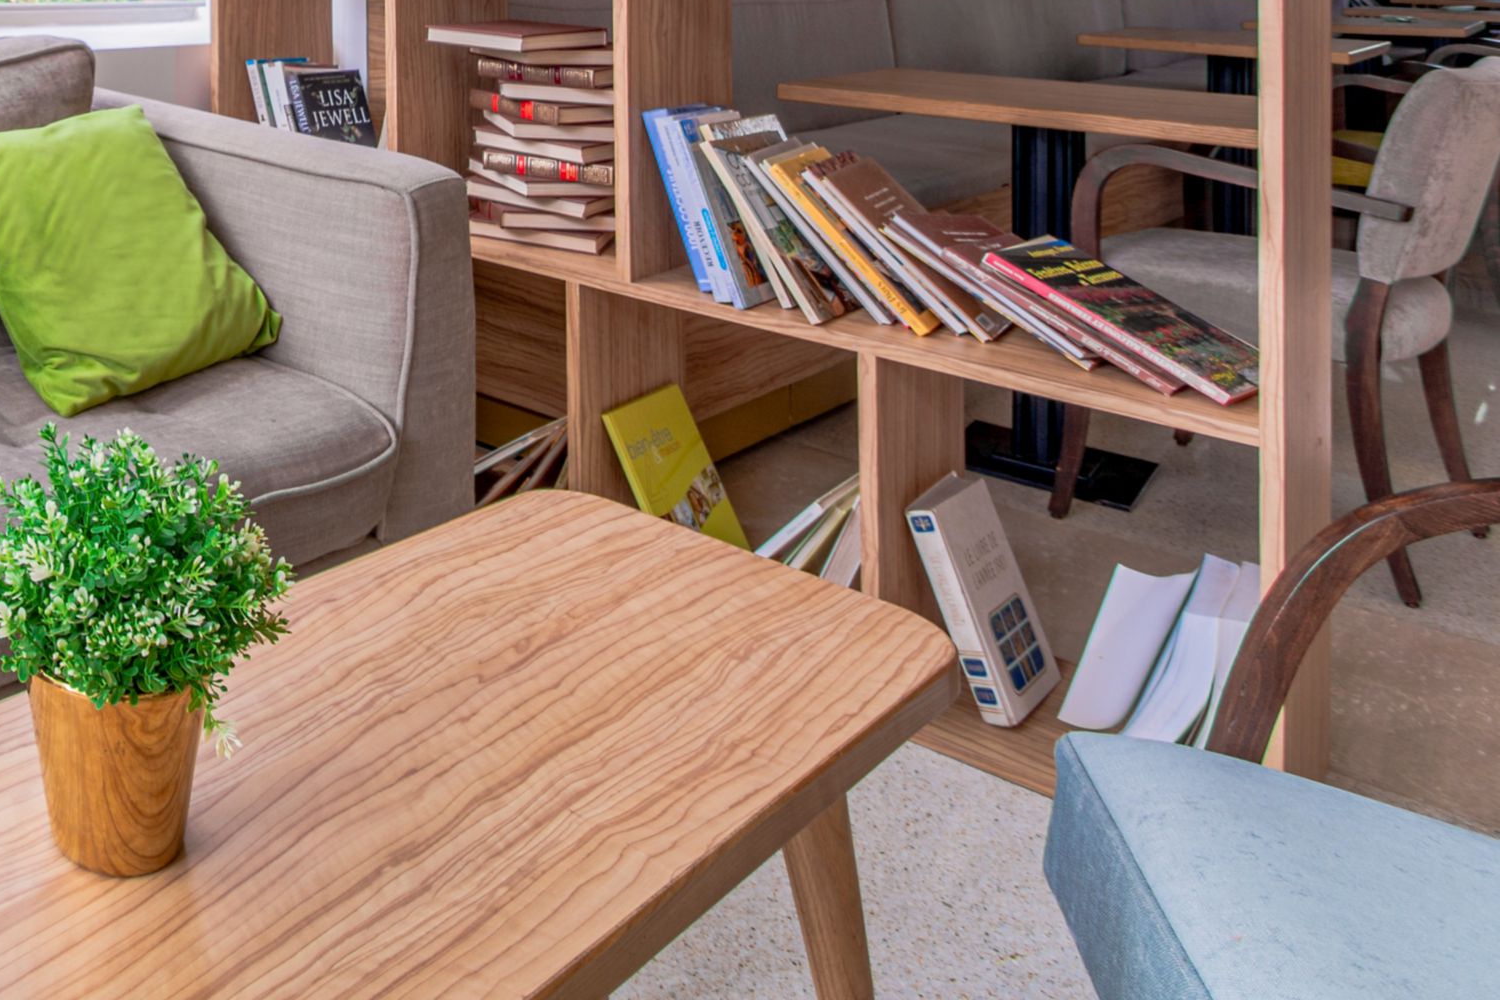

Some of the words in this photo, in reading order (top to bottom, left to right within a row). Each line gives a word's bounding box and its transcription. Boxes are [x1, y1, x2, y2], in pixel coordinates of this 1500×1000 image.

[289, 80, 300, 100] LISA
[319, 88, 354, 107] LISA
[312, 107, 371, 130] JEWELL
